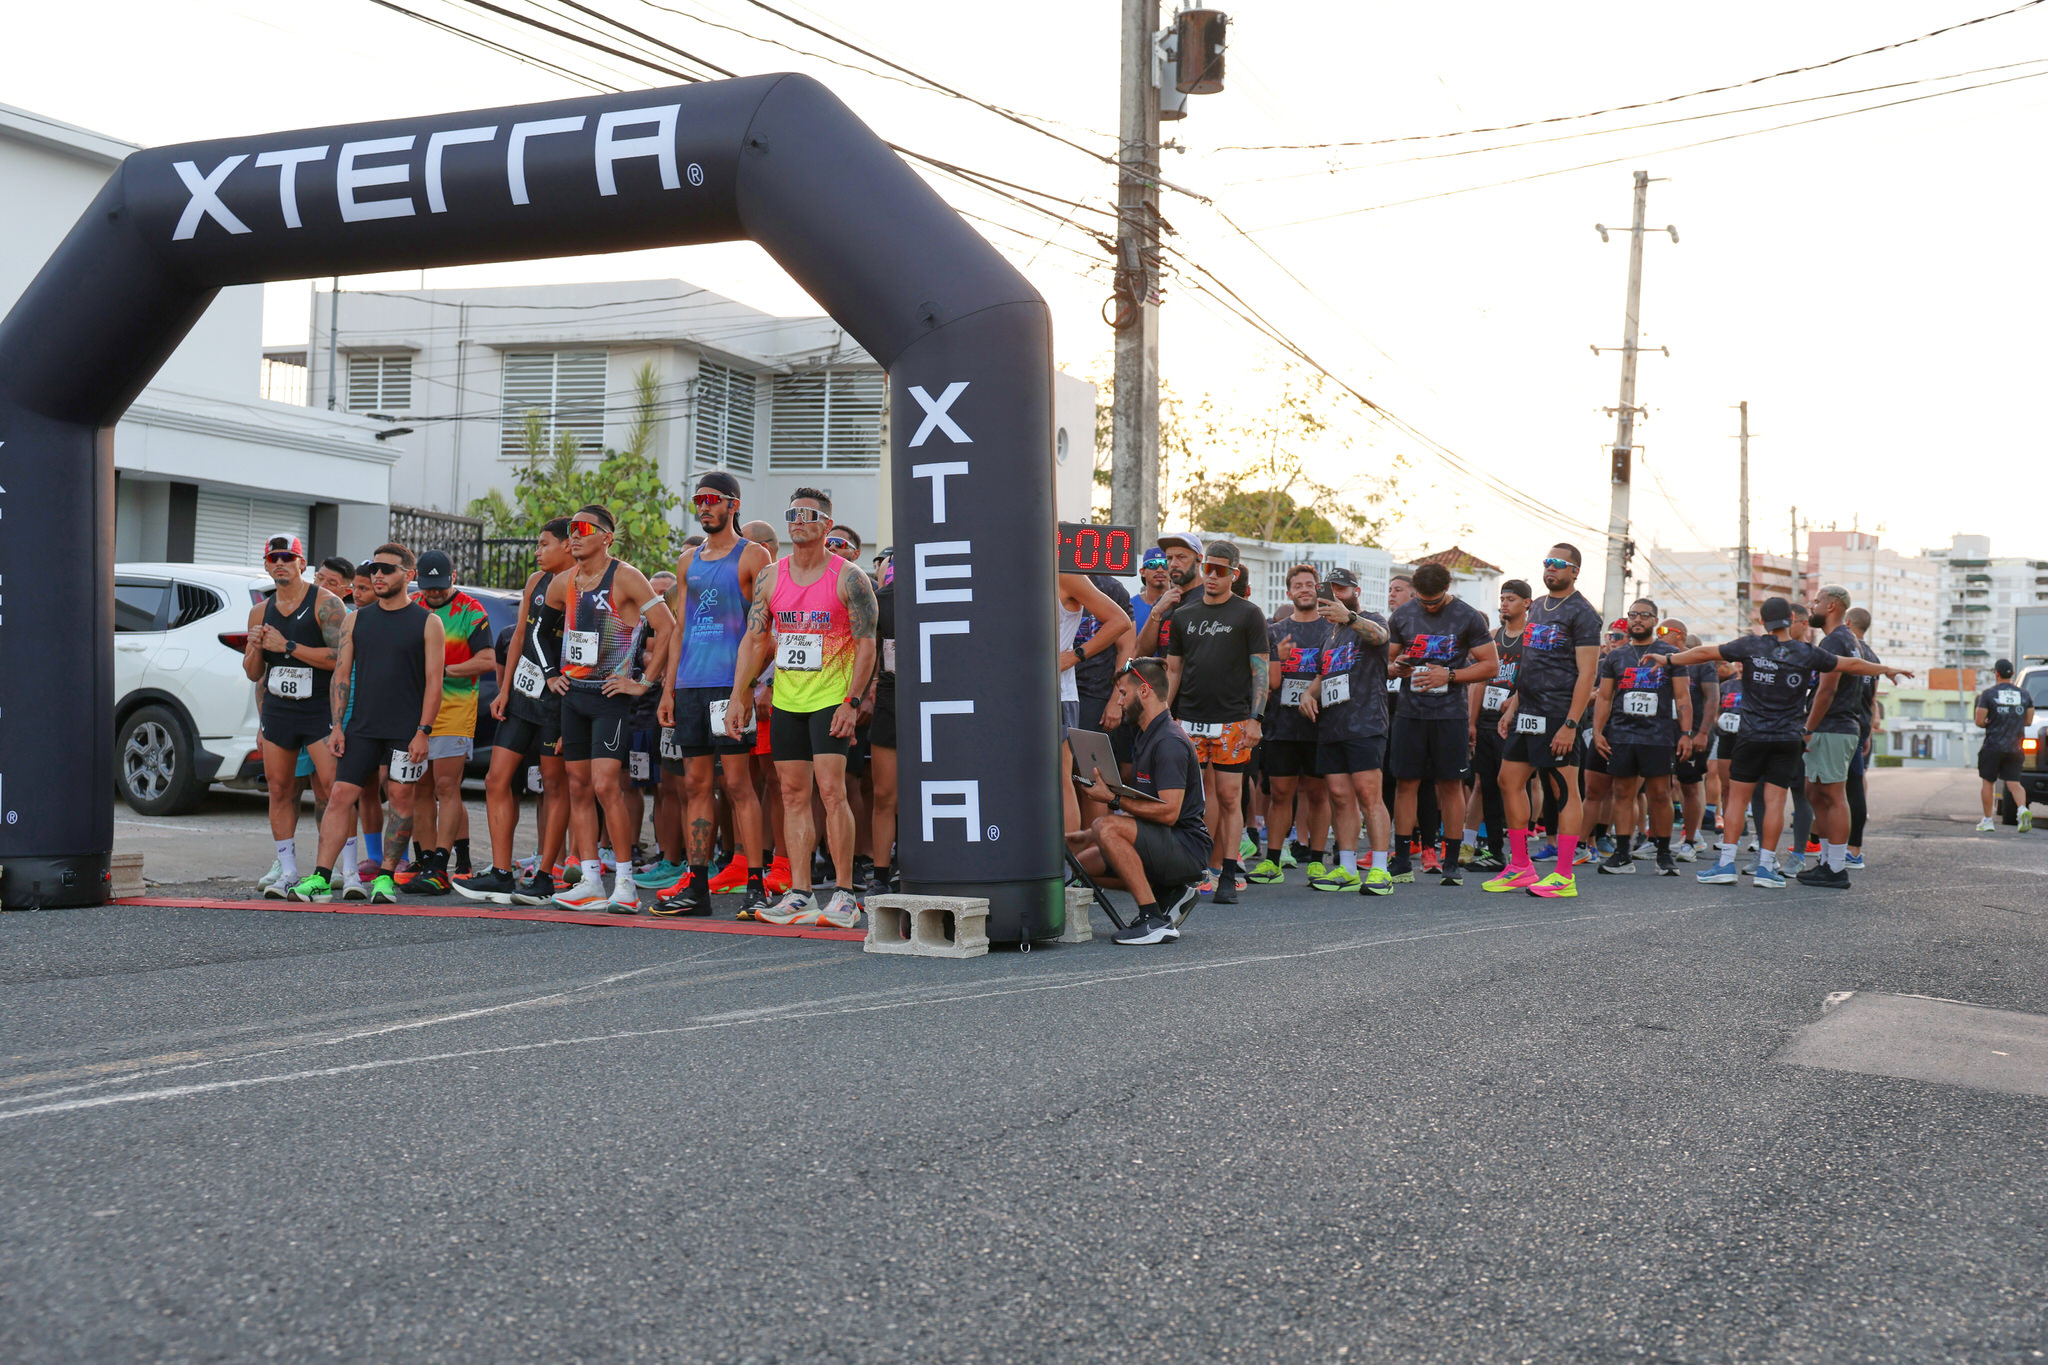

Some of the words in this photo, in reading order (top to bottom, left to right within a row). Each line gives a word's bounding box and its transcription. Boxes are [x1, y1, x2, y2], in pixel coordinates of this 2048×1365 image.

[777, 611, 797, 623] TIME
[811, 610, 831, 624] RUN
[1523, 622, 1550, 641] 5K
[1411, 634, 1449, 652] 5K
[570, 646, 583, 661] 95
[787, 650, 806, 665] 29
[1286, 647, 1320, 666] 5K
[1321, 645, 1347, 669] 5K
[516, 672, 535, 691] 158
[1622, 667, 1652, 683] 5K
[1753, 671, 1776, 683] EME
[280, 681, 297, 694] 68
[1326, 689, 1339, 702] 10
[1487, 697, 1498, 707] 37
[1630, 701, 1649, 713] 121
[1520, 717, 1538, 730] 105
[401, 765, 423, 779] 118
